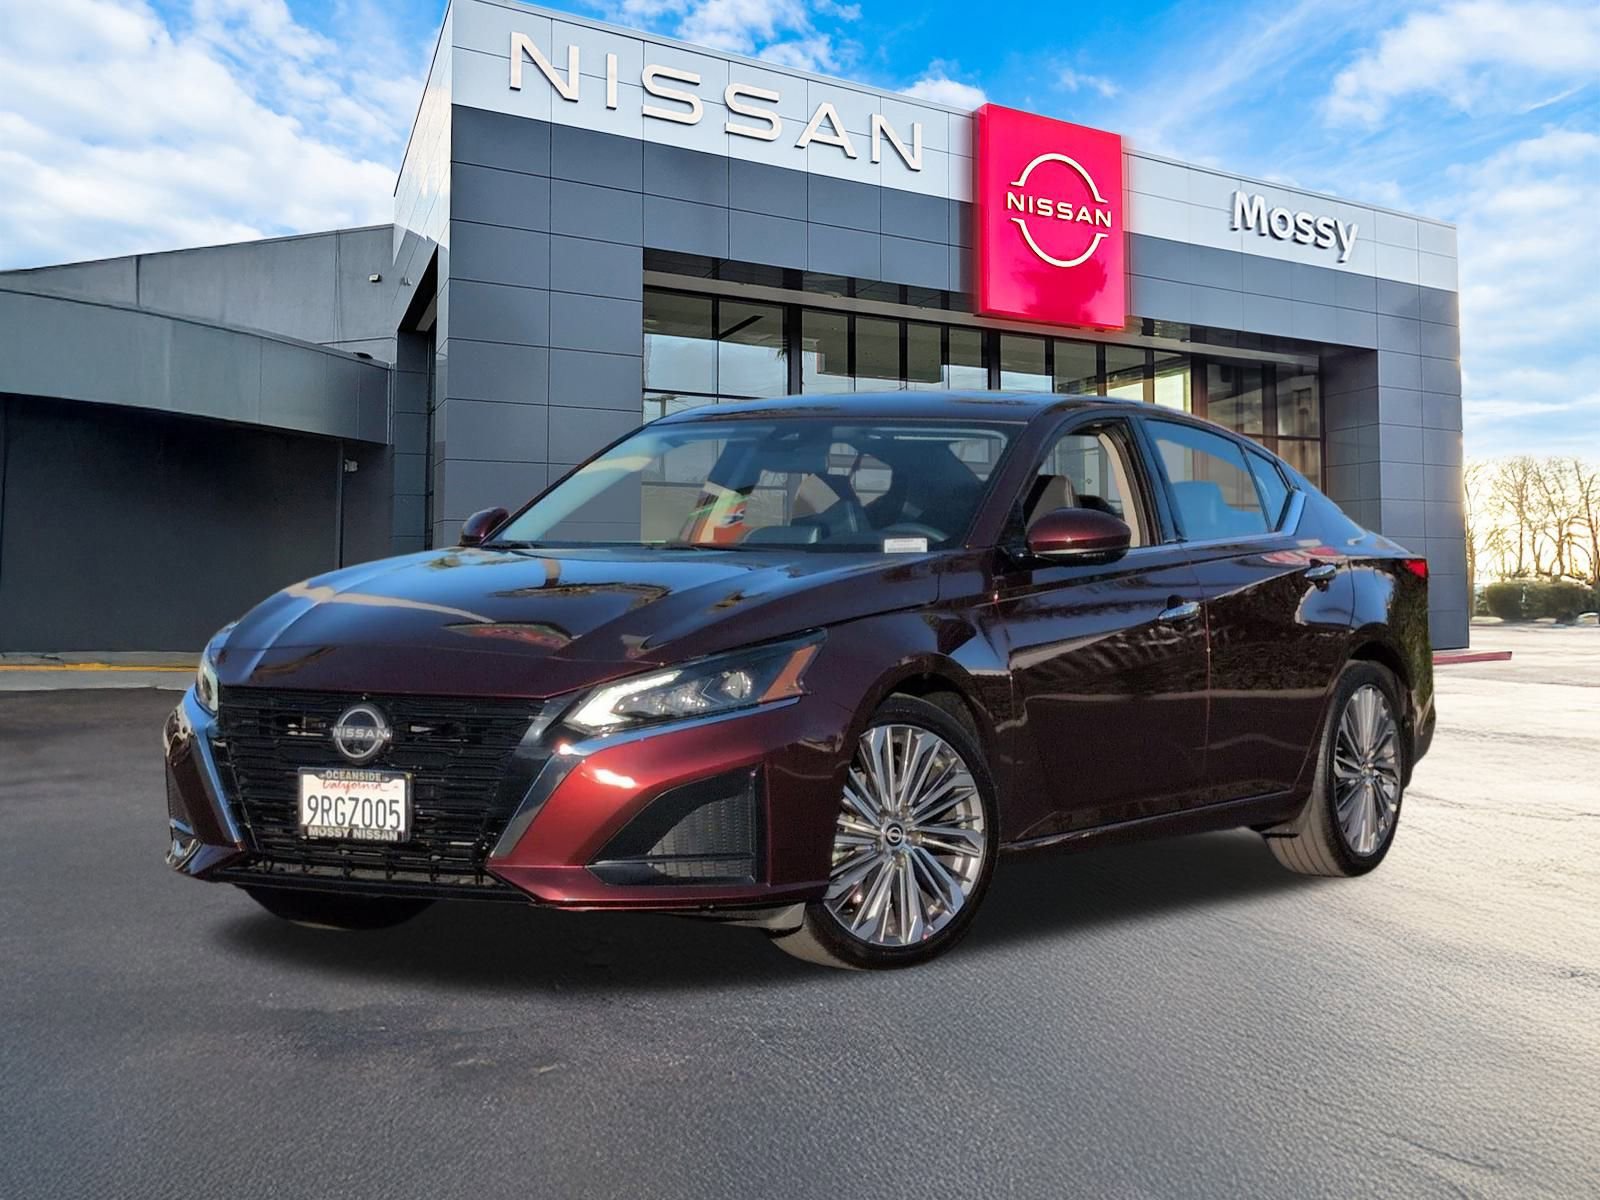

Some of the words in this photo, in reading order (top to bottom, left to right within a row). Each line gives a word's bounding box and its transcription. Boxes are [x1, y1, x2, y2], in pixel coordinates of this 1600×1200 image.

[509, 31, 922, 172] NISSAN
[1007, 191, 1112, 228] NISSAN
[1231, 190, 1359, 262] Mossy
[332, 727, 389, 738] NISSAN
[323, 781, 387, 794] California
[326, 770, 382, 781] OCEANSIDE
[307, 795, 401, 831] 9RGZ005
[308, 826, 350, 838] MOSSY
[352, 828, 399, 841] NISSAN
